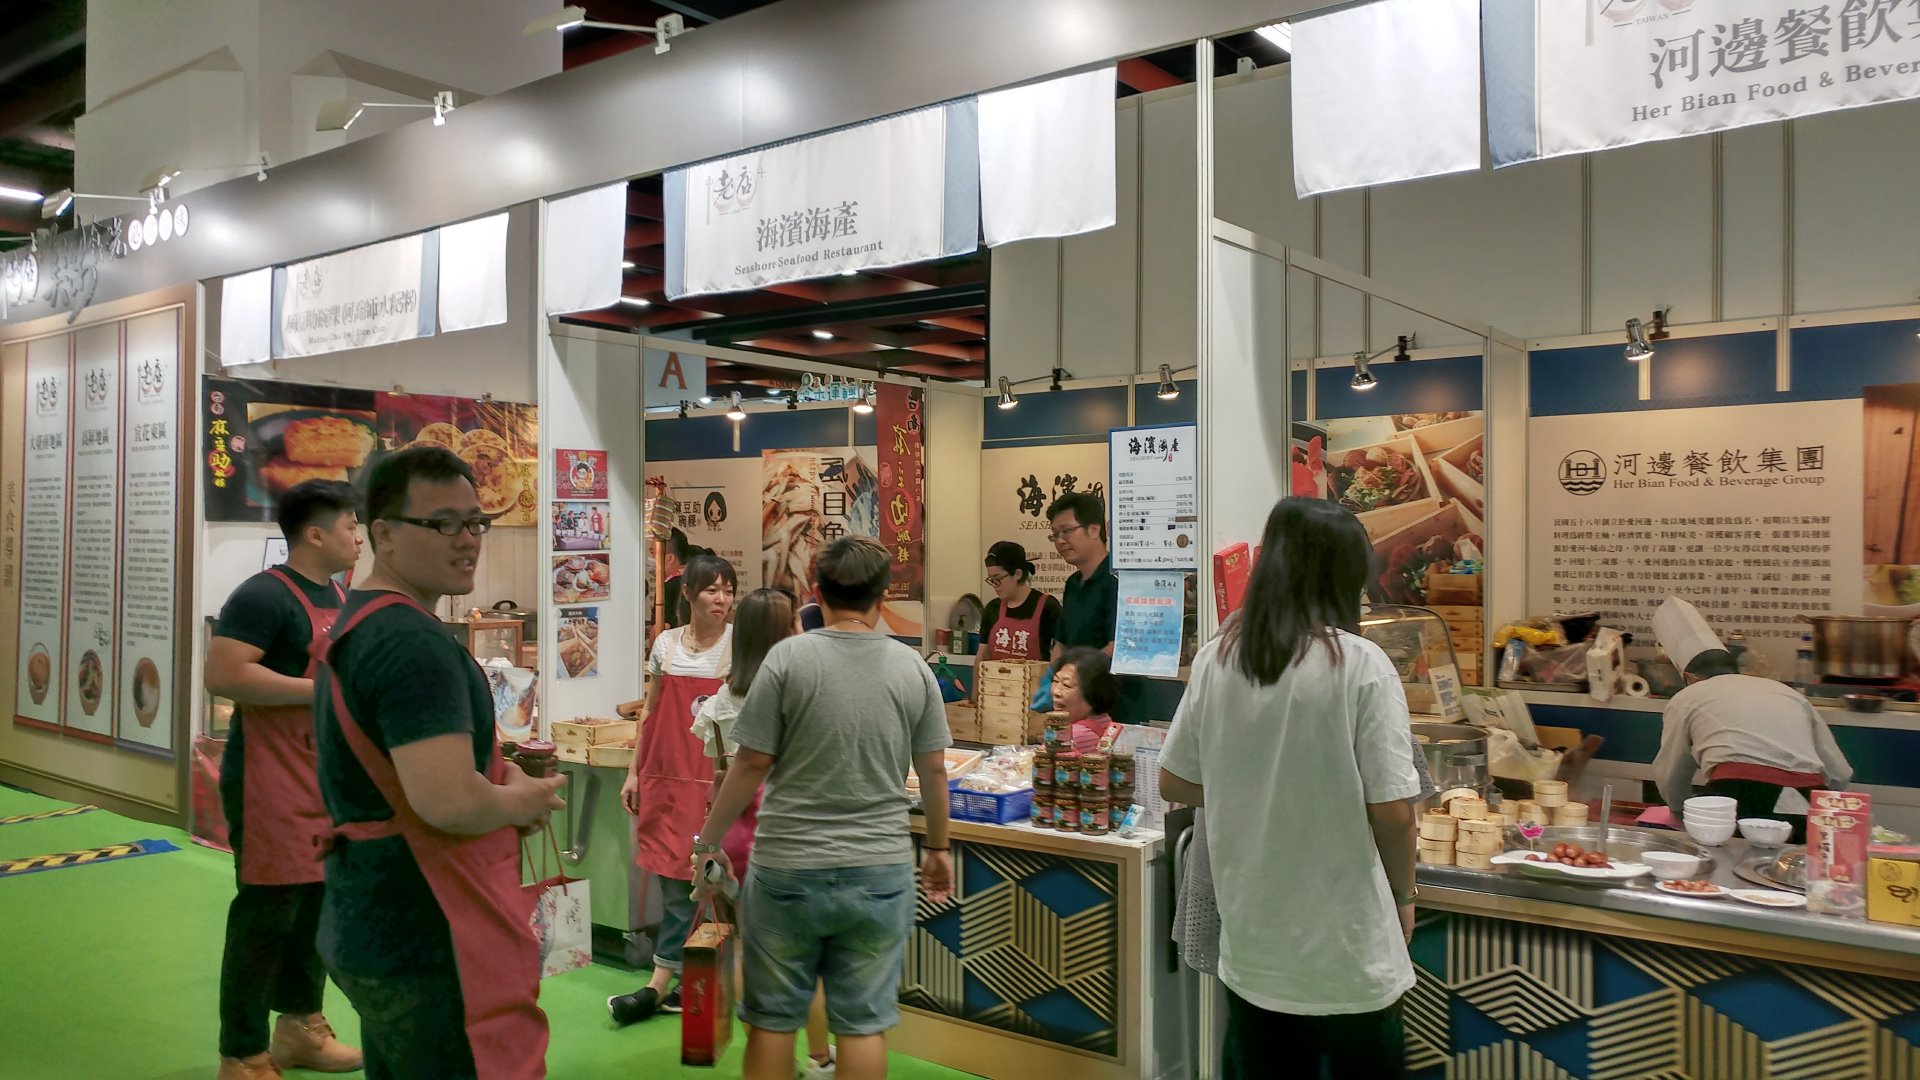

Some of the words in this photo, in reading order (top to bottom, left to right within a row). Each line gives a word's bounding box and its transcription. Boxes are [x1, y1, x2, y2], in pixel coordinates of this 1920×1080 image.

[1635, 13, 1670, 25] TAIWAN
[1649, 0, 1920, 89] 河邊餐飲
[1632, 105, 1672, 122] Her
[1681, 92, 1736, 112] Bian
[1747, 76, 1808, 101] Food
[1818, 71, 1835, 88] &
[756, 200, 858, 252] 海濱海產
[778, 251, 819, 267] Seafood
[823, 239, 884, 260] Restaurant
[658, 351, 688, 390] A
[1613, 445, 1825, 477] 河邊餐飲集團
[1613, 479, 1635, 489] Her
[1638, 479, 1665, 488] Bian
[1669, 478, 1700, 488] Food
[1703, 476, 1714, 486] &
[1719, 476, 1779, 487] Beverage
[1782, 474, 1825, 486] Group
[995, 627, 1031, 651] 海濱
